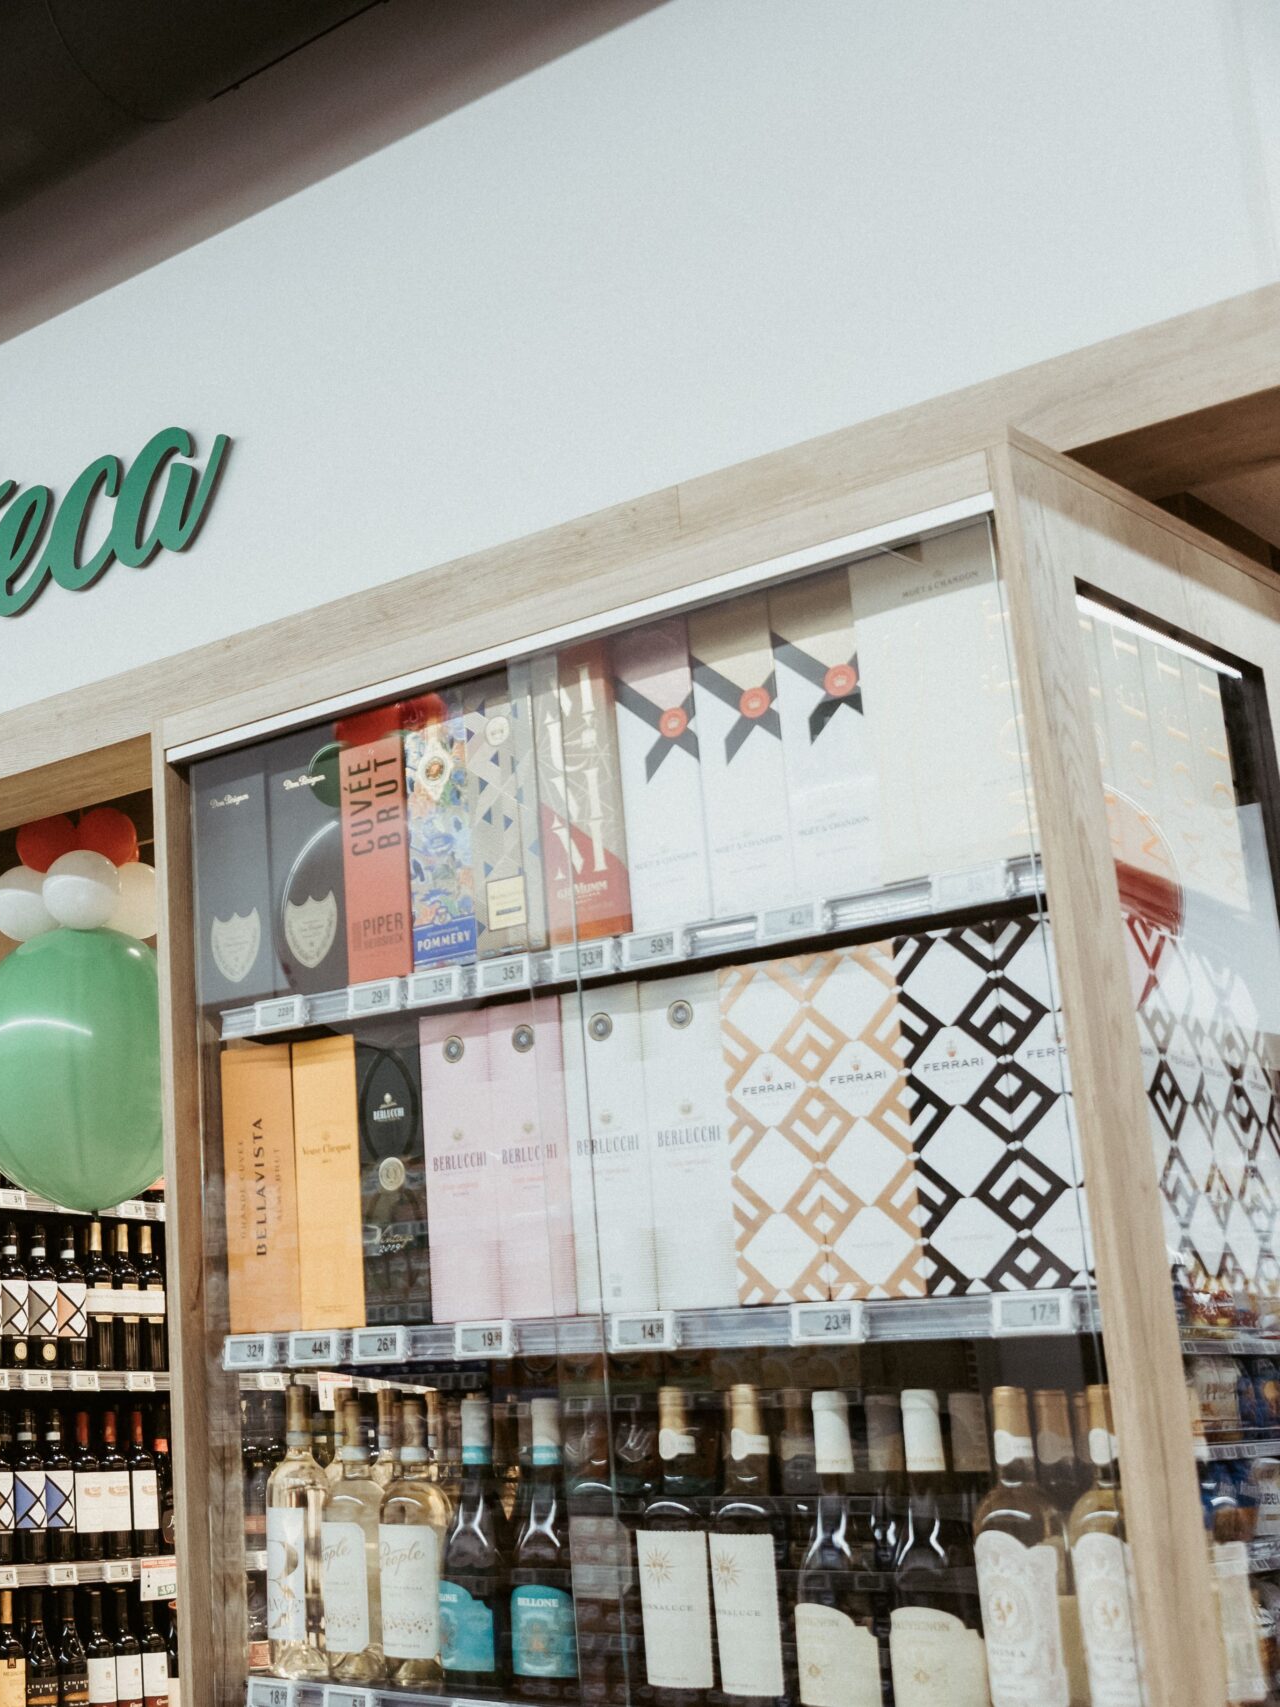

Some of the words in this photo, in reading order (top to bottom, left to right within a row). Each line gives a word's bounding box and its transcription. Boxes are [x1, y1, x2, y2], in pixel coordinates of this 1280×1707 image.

[373, 755, 403, 850] BRUT
[363, 912, 404, 938] PIPER
[416, 930, 472, 953] POMMERY
[923, 1057, 985, 1074] FERRARI
[742, 1080, 797, 1098] FERRARI
[829, 1070, 888, 1086] FERRARI
[373, 1107, 405, 1121] BERLUCCHI
[576, 1133, 640, 1157] BERLUCCHI
[657, 1124, 721, 1149] BERLUCCHI
[432, 1150, 487, 1173] BERLUCCHI
[502, 1143, 558, 1165] BERLUCHI
[251, 1117, 268, 1257] BELLAVISTA
